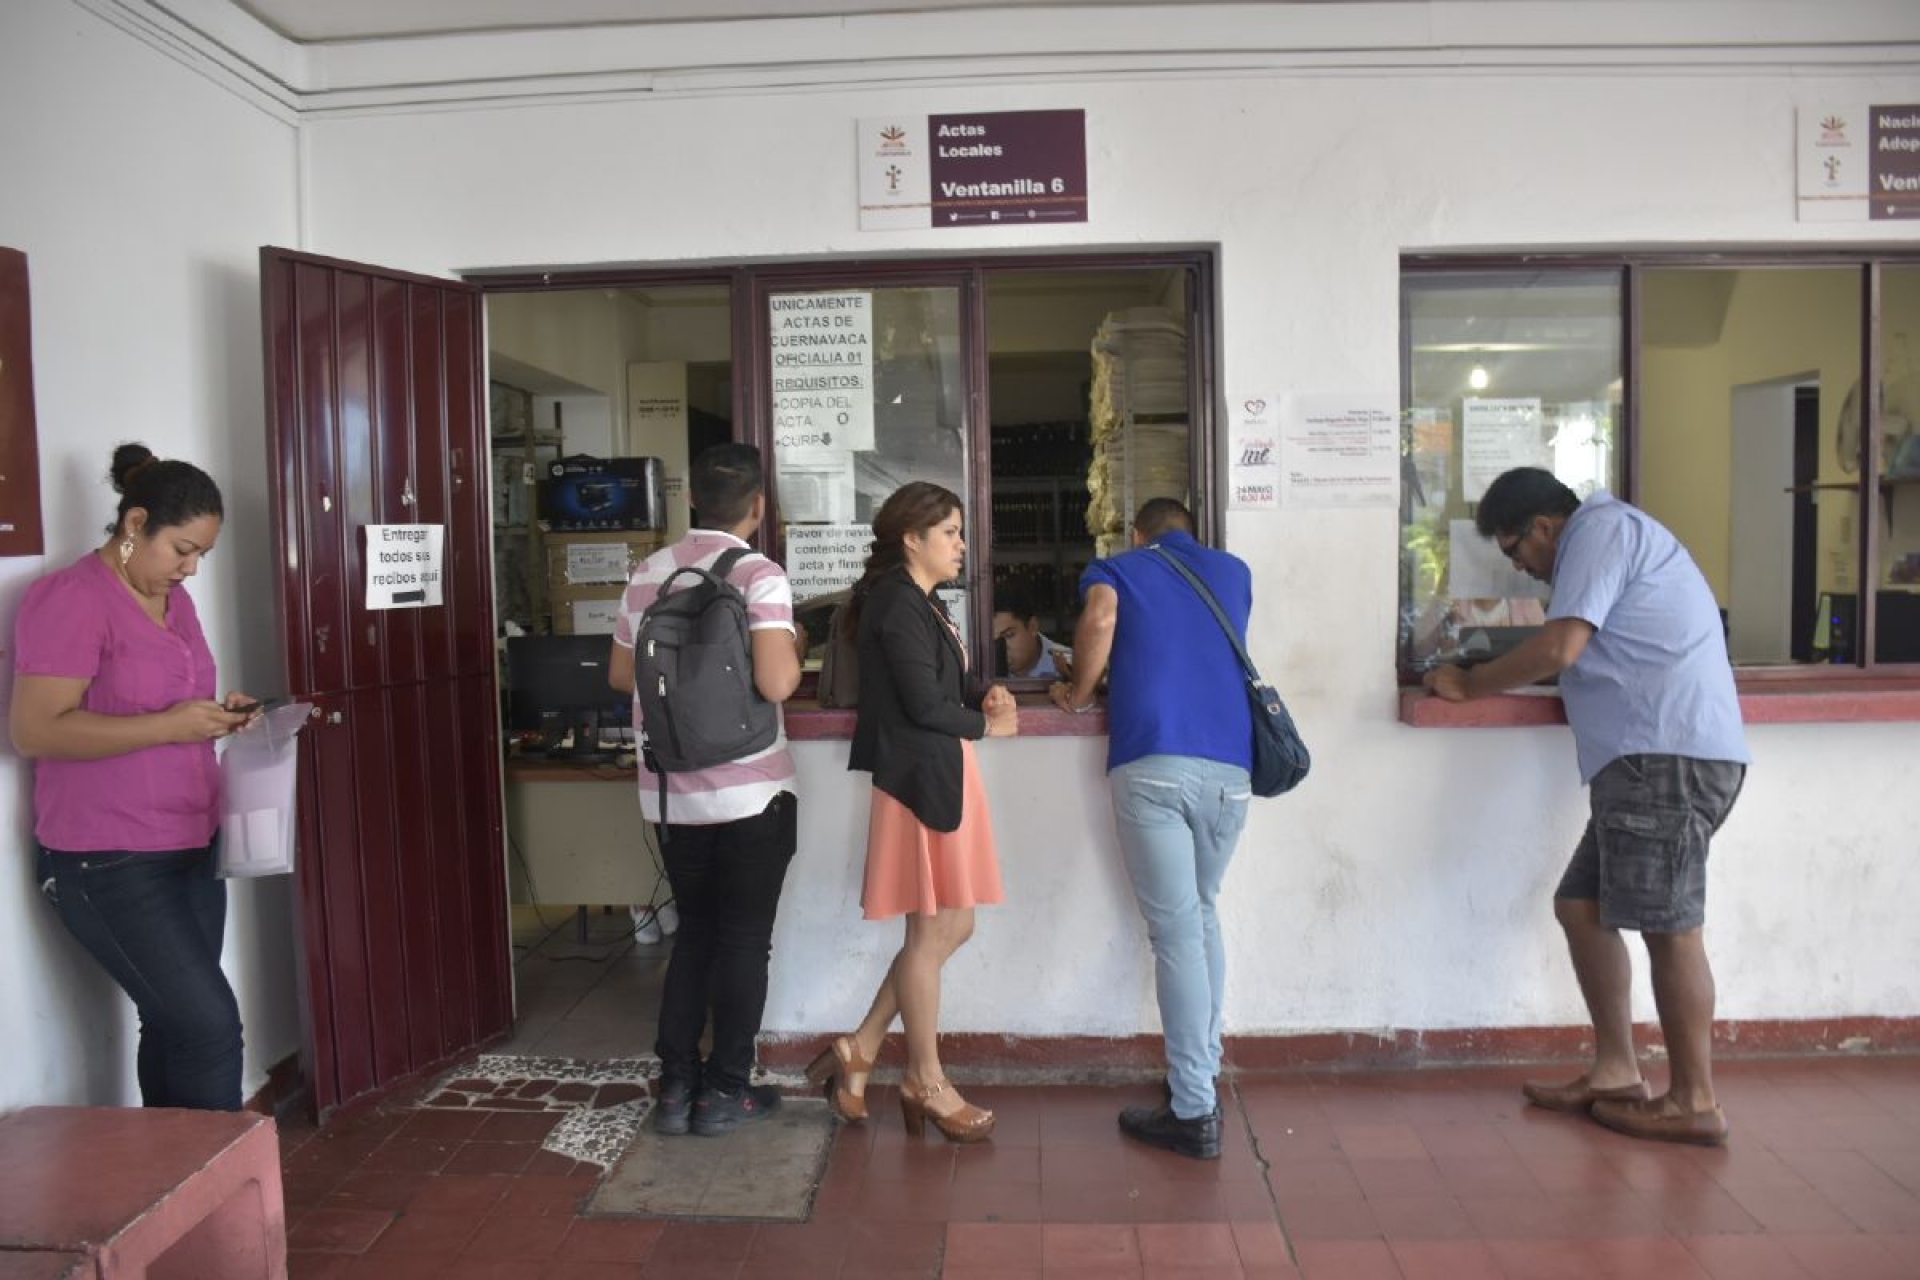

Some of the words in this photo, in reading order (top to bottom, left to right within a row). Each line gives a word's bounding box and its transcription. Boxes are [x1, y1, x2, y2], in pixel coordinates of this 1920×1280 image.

[938, 124, 986, 138] Actas
[938, 143, 1003, 158] Locales
[940, 178, 1046, 198] Ventanilla
[1050, 177, 1065, 193] 6
[1879, 173, 1920, 191] Ven
[783, 315, 829, 329] ACTAS
[834, 315, 854, 328] DE
[771, 333, 867, 347] CUERNAVACA
[847, 351, 862, 363] 01
[780, 397, 823, 410] COPIA
[826, 396, 853, 409] DEL
[777, 414, 813, 428] ACTA
[790, 527, 822, 539] Favor
[794, 543, 857, 555] contenido
[379, 550, 414, 563] todos
[798, 560, 825, 571] acta
[828, 562, 834, 573] y
[372, 570, 417, 586] recibos
